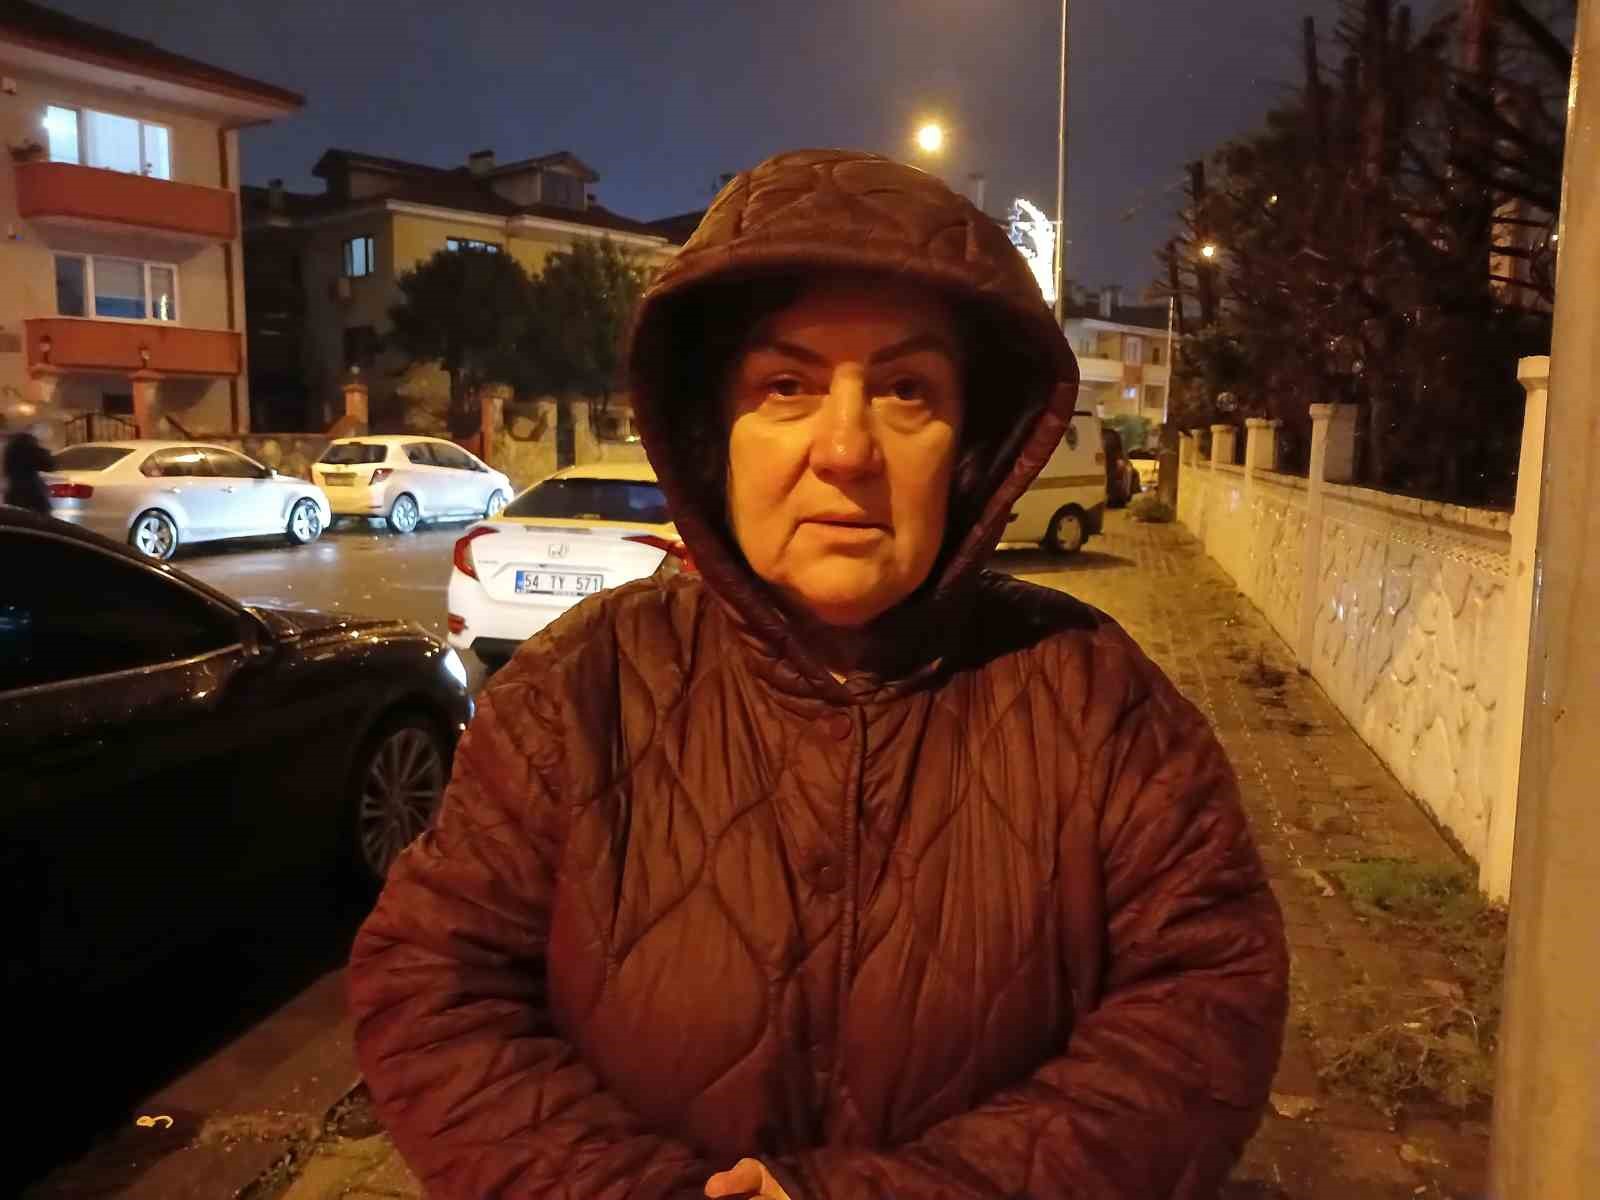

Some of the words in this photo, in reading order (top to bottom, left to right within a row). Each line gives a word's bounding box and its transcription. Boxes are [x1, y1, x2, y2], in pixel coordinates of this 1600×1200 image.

[525, 574, 539, 588] 54
[551, 575, 566, 589] TY
[576, 576, 599, 592] 571
